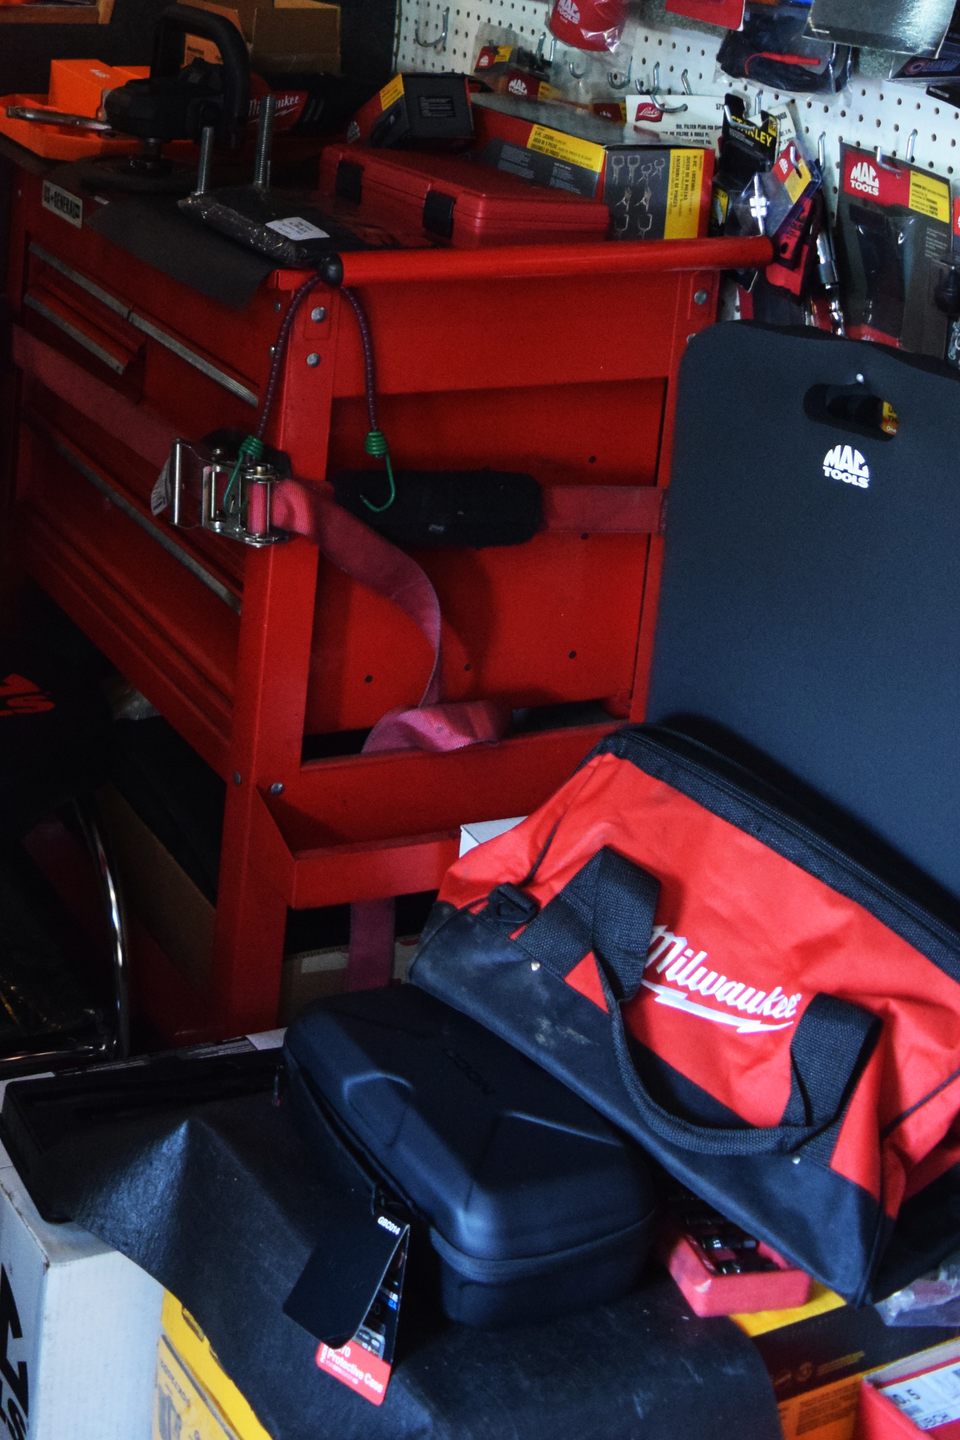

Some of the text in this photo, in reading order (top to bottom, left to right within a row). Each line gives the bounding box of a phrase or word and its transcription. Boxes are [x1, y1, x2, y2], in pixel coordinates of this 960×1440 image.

[556, 8, 581, 25] TOOLS
[509, 78, 527, 91] MAC
[850, 162, 879, 188] MAC
[850, 179, 879, 196] TOOLS
[823, 444, 870, 479] MAC
[822, 466, 870, 489] TOOLS
[645, 925, 797, 1019] Milwaukee
[377, 1216, 401, 1236] GBC014
[326, 1349, 365, 1380] Protective
[364, 1372, 384, 1394] Case
